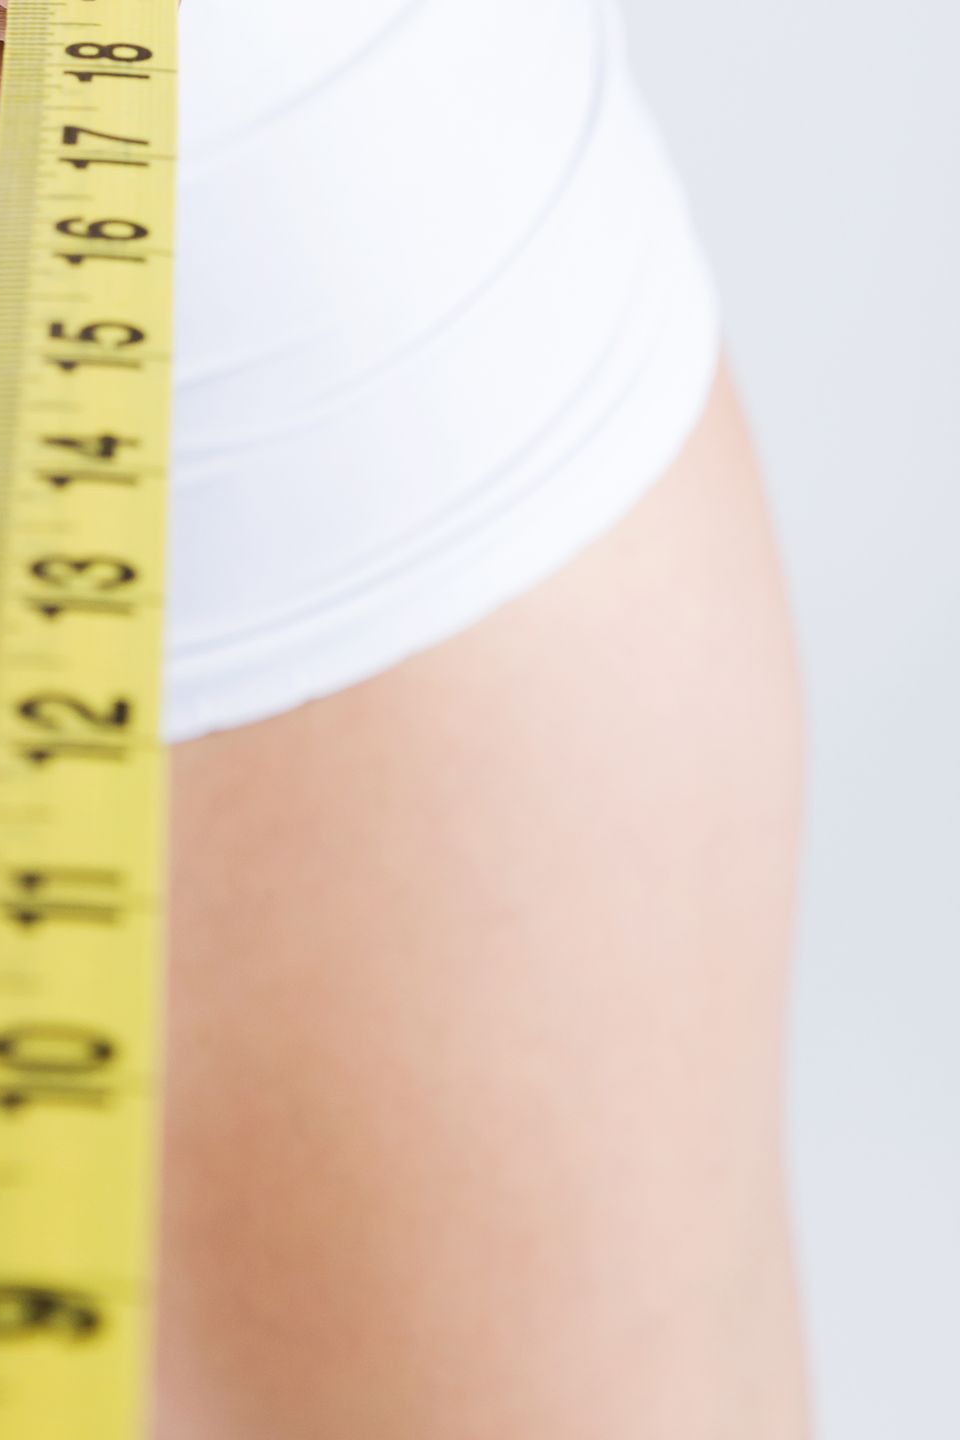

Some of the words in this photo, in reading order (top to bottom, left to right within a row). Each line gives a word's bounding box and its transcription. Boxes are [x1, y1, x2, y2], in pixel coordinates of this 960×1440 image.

[64, 42, 152, 82] 18
[58, 126, 149, 169] 17
[53, 217, 149, 266] 16
[43, 321, 146, 374] 15
[36, 433, 144, 489] 14
[27, 554, 139, 622] 13
[13, 689, 134, 768] 12
[2, 866, 121, 930] 11
